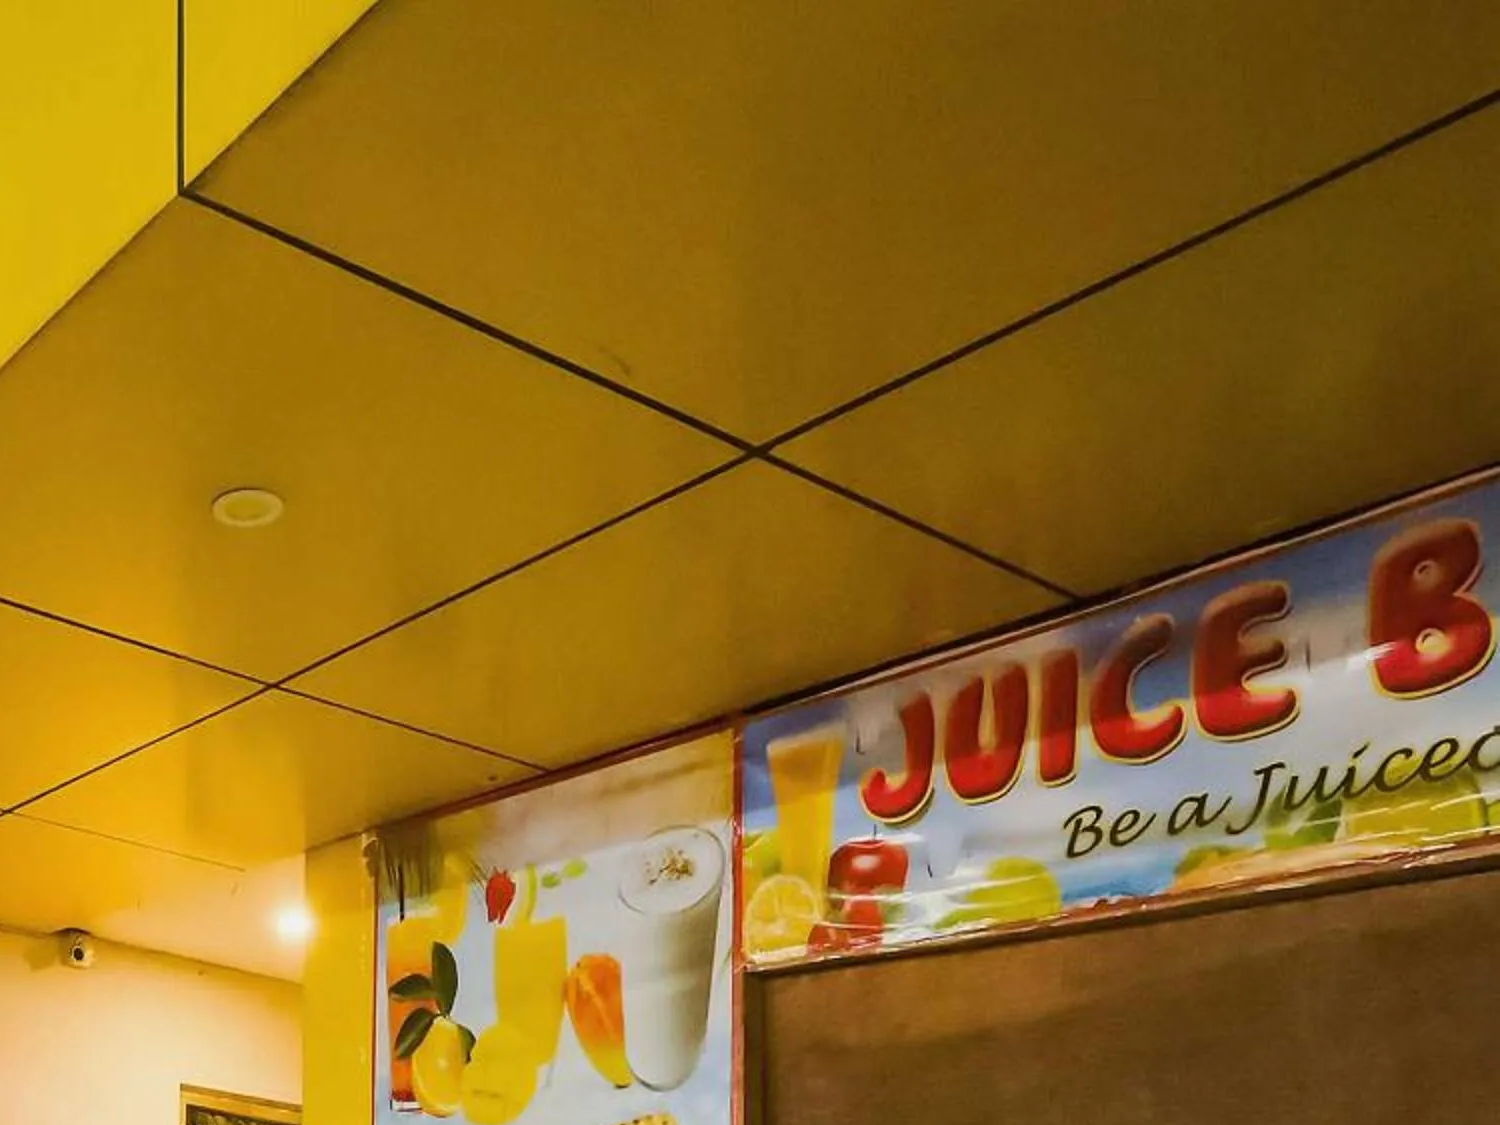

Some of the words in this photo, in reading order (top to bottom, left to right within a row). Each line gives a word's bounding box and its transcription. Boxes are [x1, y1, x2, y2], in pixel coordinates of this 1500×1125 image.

[860, 579, 1299, 824] JUICE
[1062, 804, 1157, 859] Be
[1166, 791, 1232, 837] a
